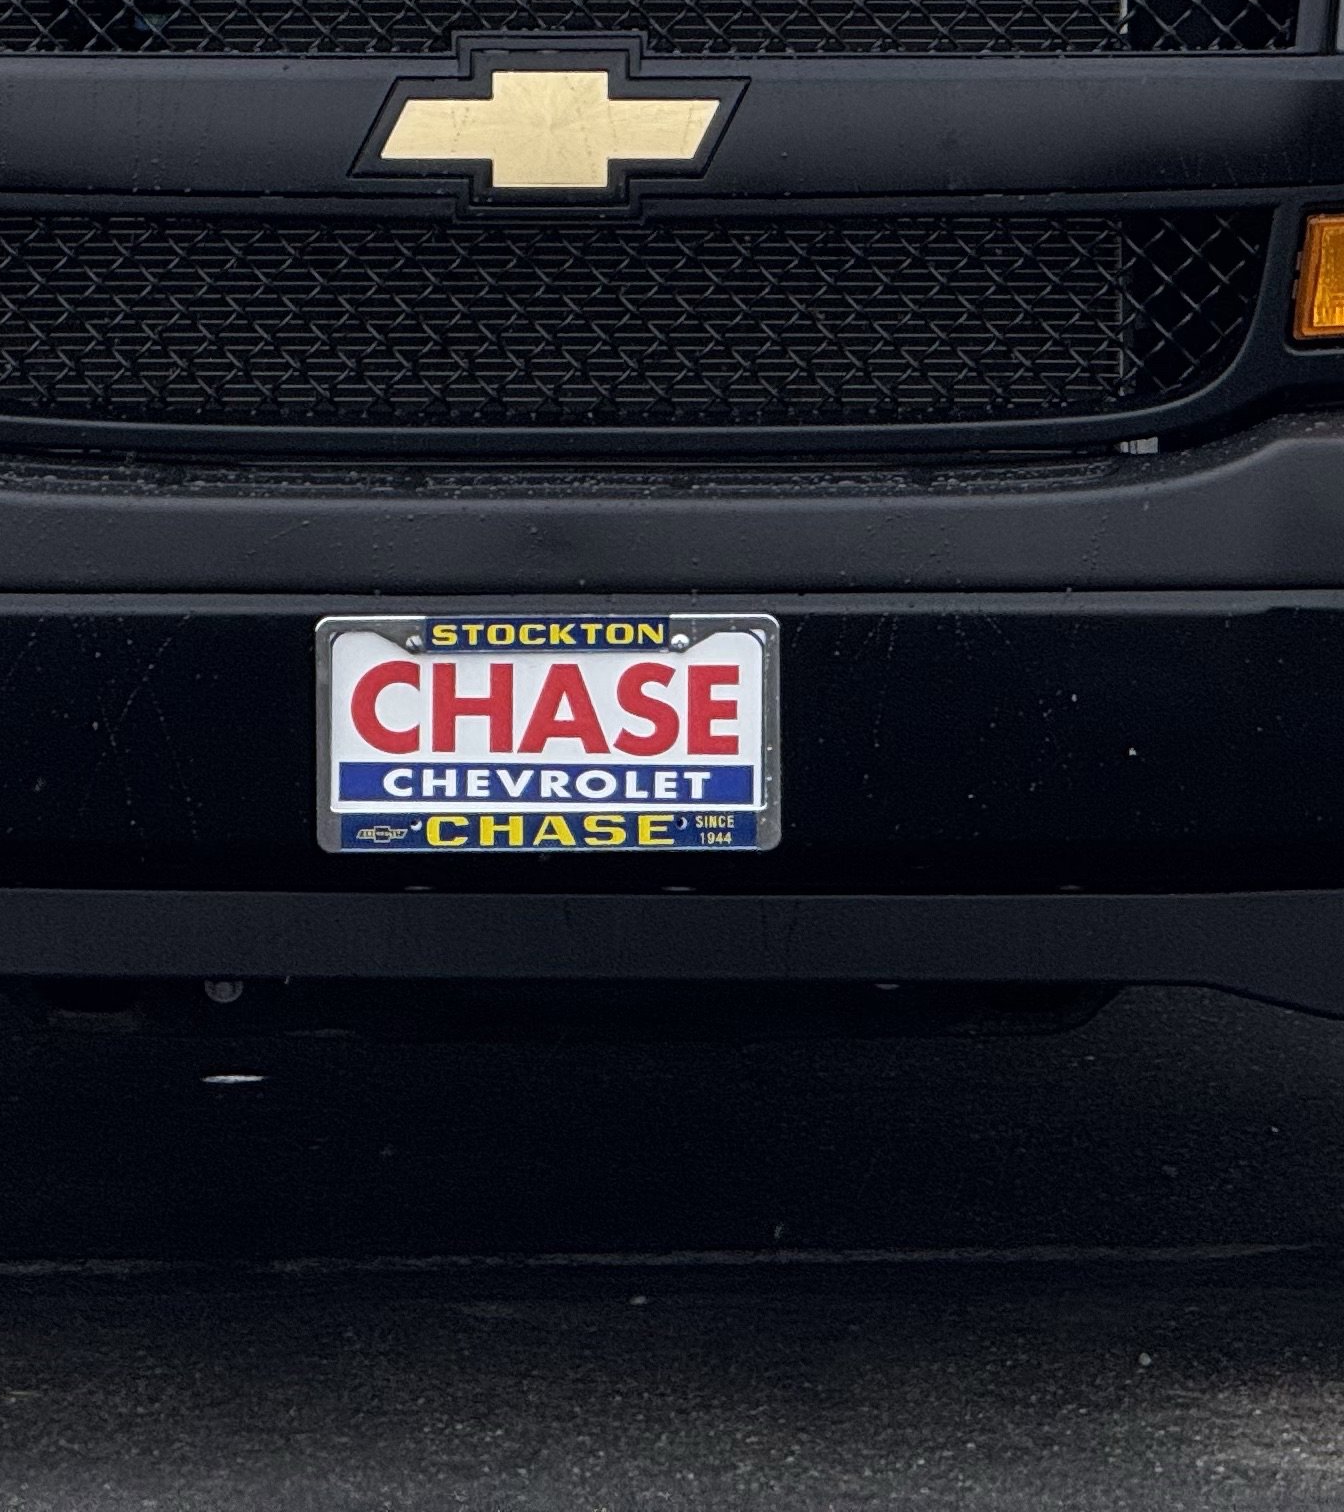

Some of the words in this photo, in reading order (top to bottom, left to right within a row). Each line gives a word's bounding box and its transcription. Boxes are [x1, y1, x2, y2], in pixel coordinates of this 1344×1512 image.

[431, 622, 664, 646] STOCKTON
[350, 660, 740, 757] CHASE
[382, 768, 712, 800] CHEVROLET
[425, 814, 675, 847] CHASE
[694, 815, 735, 829] SINCE
[699, 831, 733, 845] 1944
